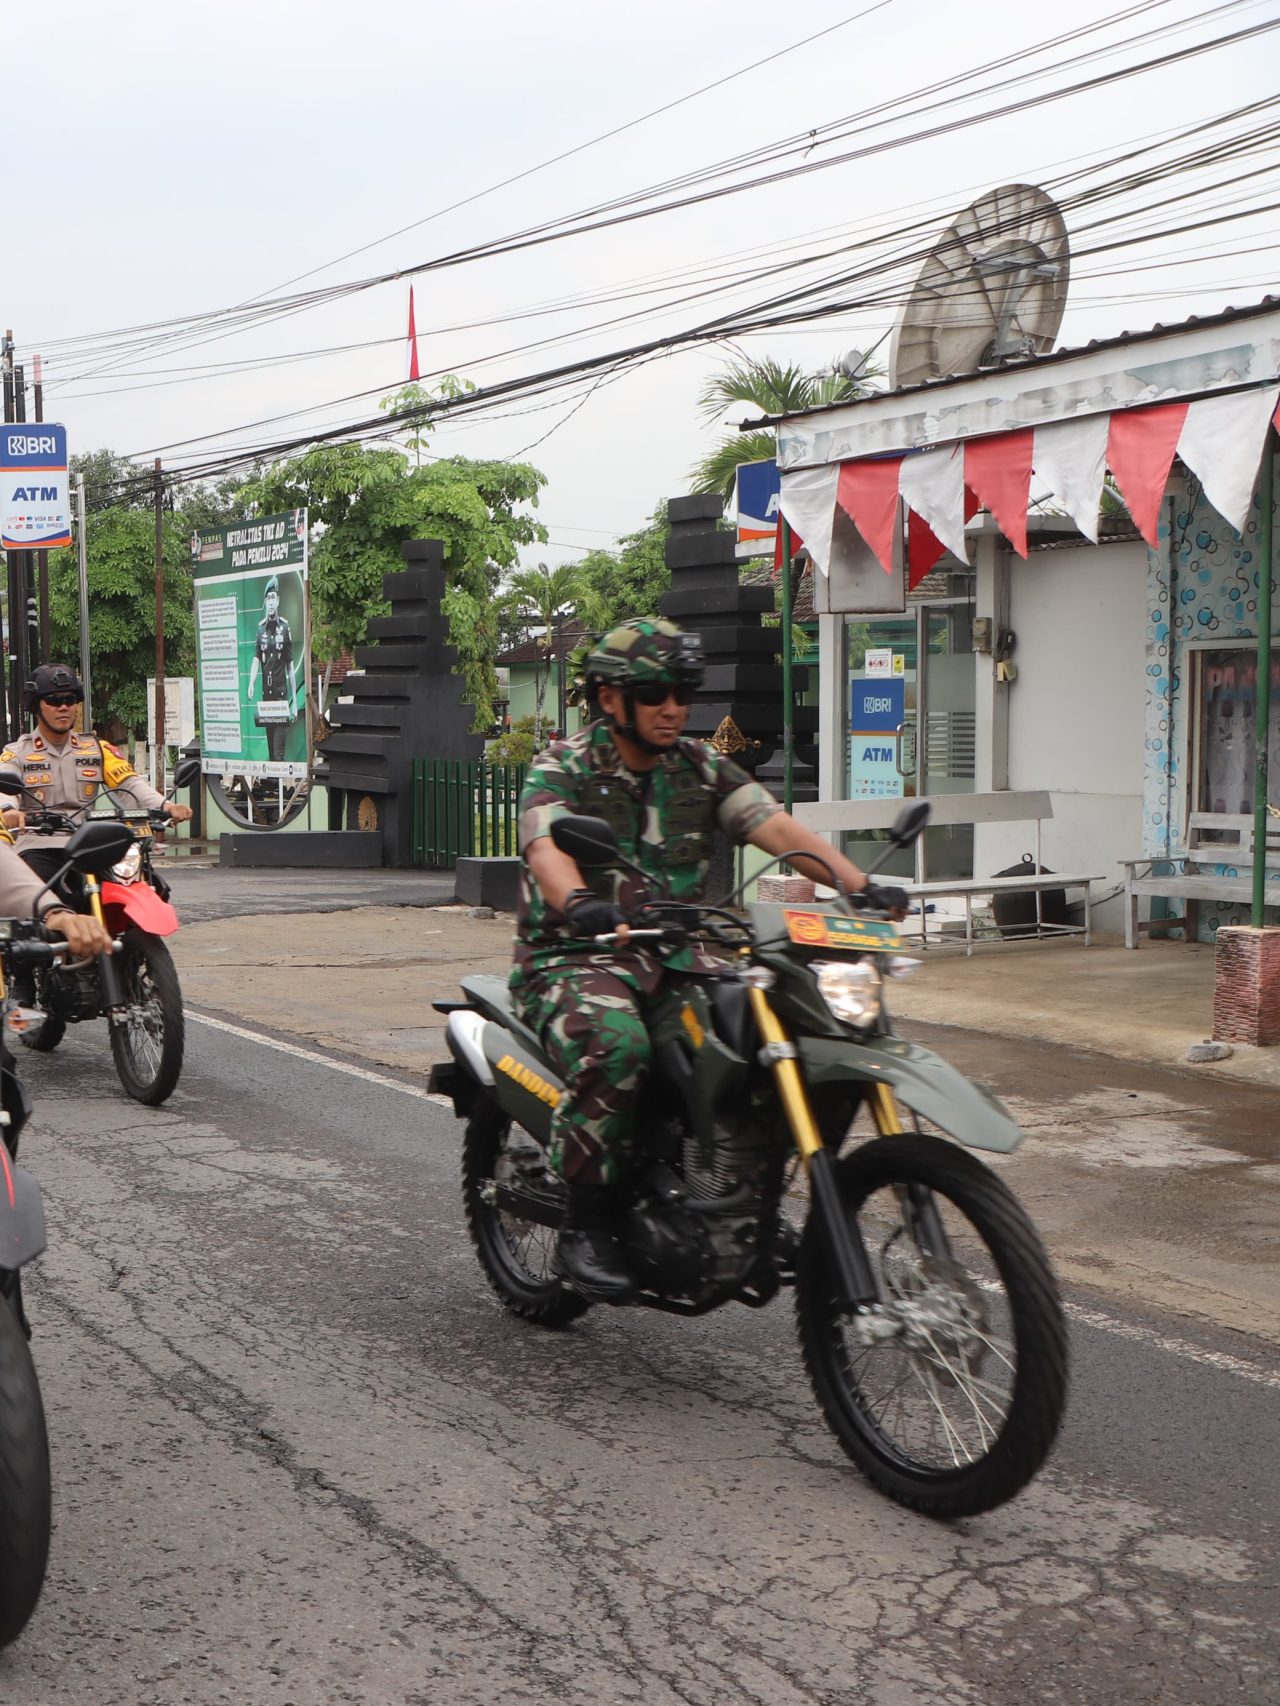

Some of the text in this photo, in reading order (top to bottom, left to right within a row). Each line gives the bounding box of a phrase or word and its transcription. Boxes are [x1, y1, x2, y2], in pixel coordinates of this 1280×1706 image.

[27, 437, 56, 454] BRI
[11, 487, 58, 501] ATM
[226, 525, 262, 548] NETRALITAS
[263, 523, 275, 541] TNI
[275, 521, 285, 540] AD
[231, 550, 247, 568] PADA
[247, 546, 271, 566] PEMILU
[271, 541, 289, 561] 2024
[874, 698, 892, 713] BRI
[862, 748, 893, 762] ATM
[23, 763, 51, 772] HERLI
[75, 758, 101, 767] POLRI
